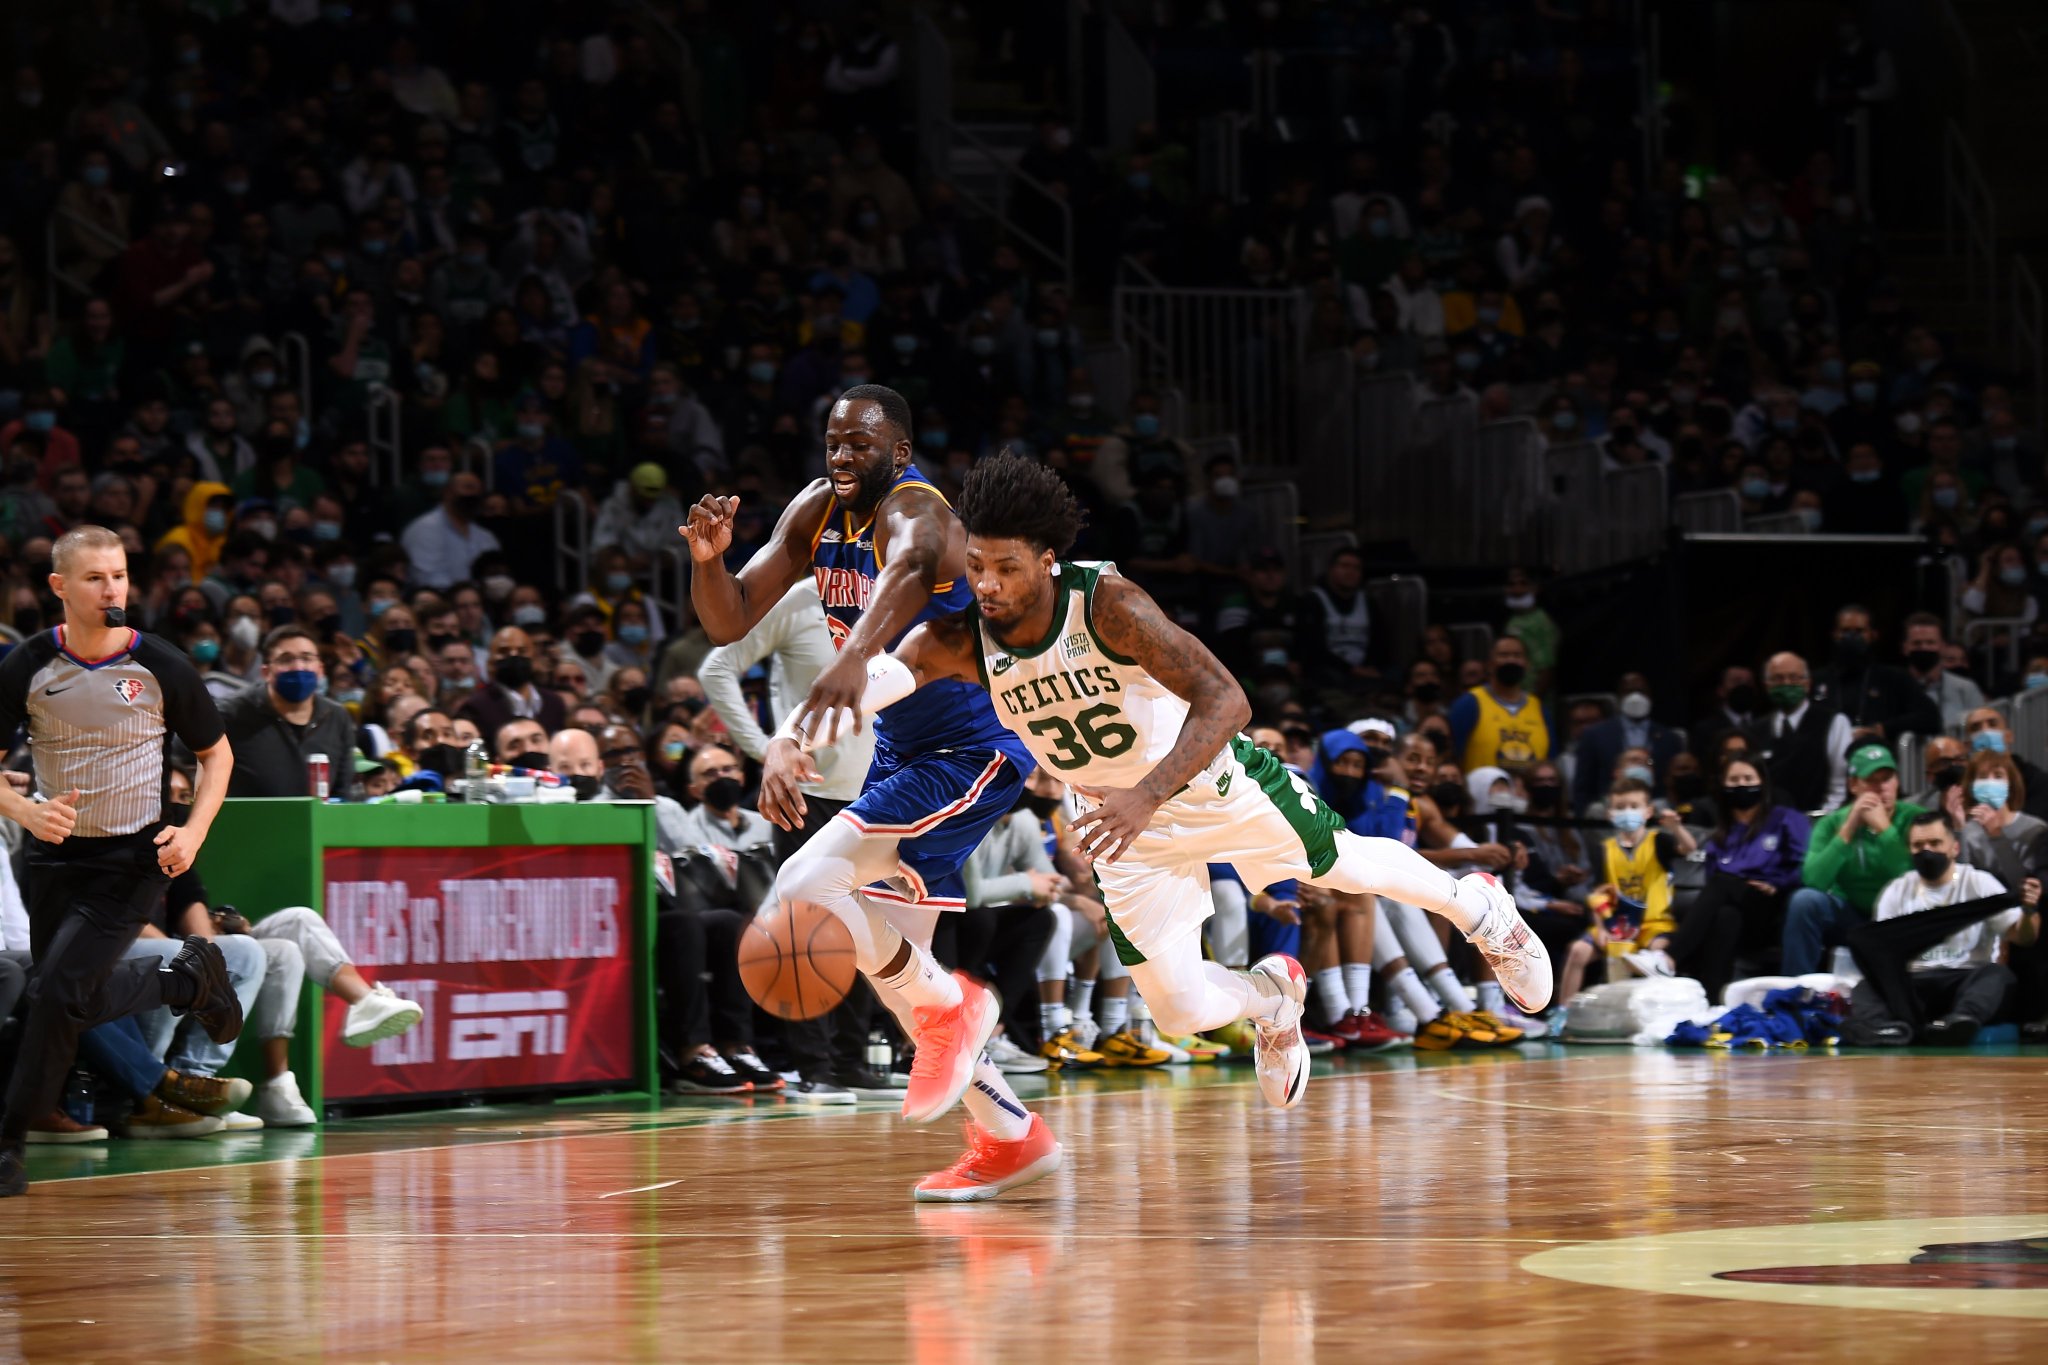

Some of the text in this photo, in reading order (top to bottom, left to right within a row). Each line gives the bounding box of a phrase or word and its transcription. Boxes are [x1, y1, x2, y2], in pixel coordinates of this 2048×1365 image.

[1063, 632, 1090, 649] VISTA
[1066, 643, 1092, 659] PRINT
[995, 655, 1014, 669] NIKE
[1000, 665, 1121, 716] CELTICS
[1027, 702, 1138, 771] 36
[1216, 769, 1234, 791] NIKE
